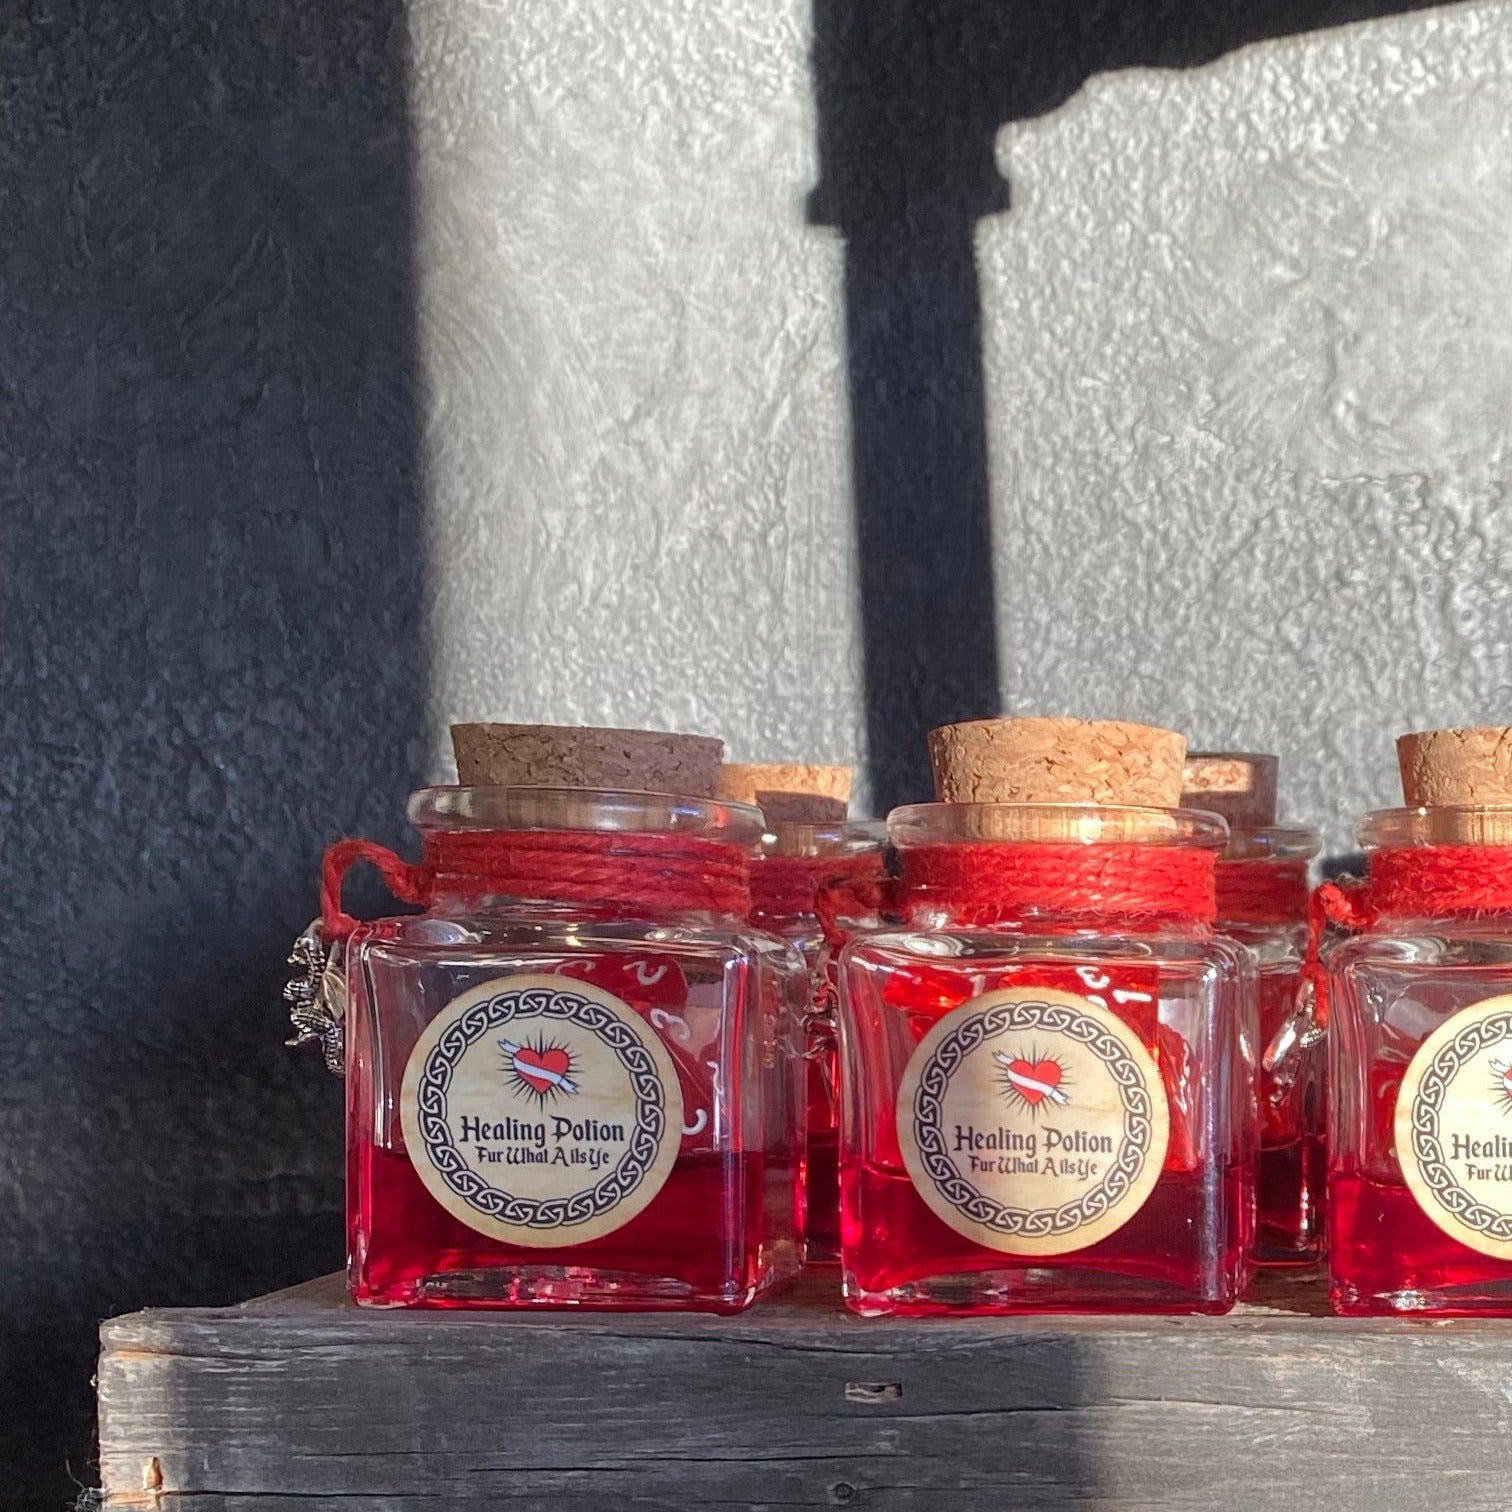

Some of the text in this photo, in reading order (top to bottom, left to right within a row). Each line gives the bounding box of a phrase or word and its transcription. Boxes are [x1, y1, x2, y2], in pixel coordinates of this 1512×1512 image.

[459, 1115, 624, 1147] Healing Potion
[954, 1125, 1112, 1158] Healing Potion
[474, 1147, 610, 1170] Fur What Ails Ye
[966, 1156, 1097, 1181] Fur What Ails Ye
[1463, 1164, 1493, 1181] Fur
